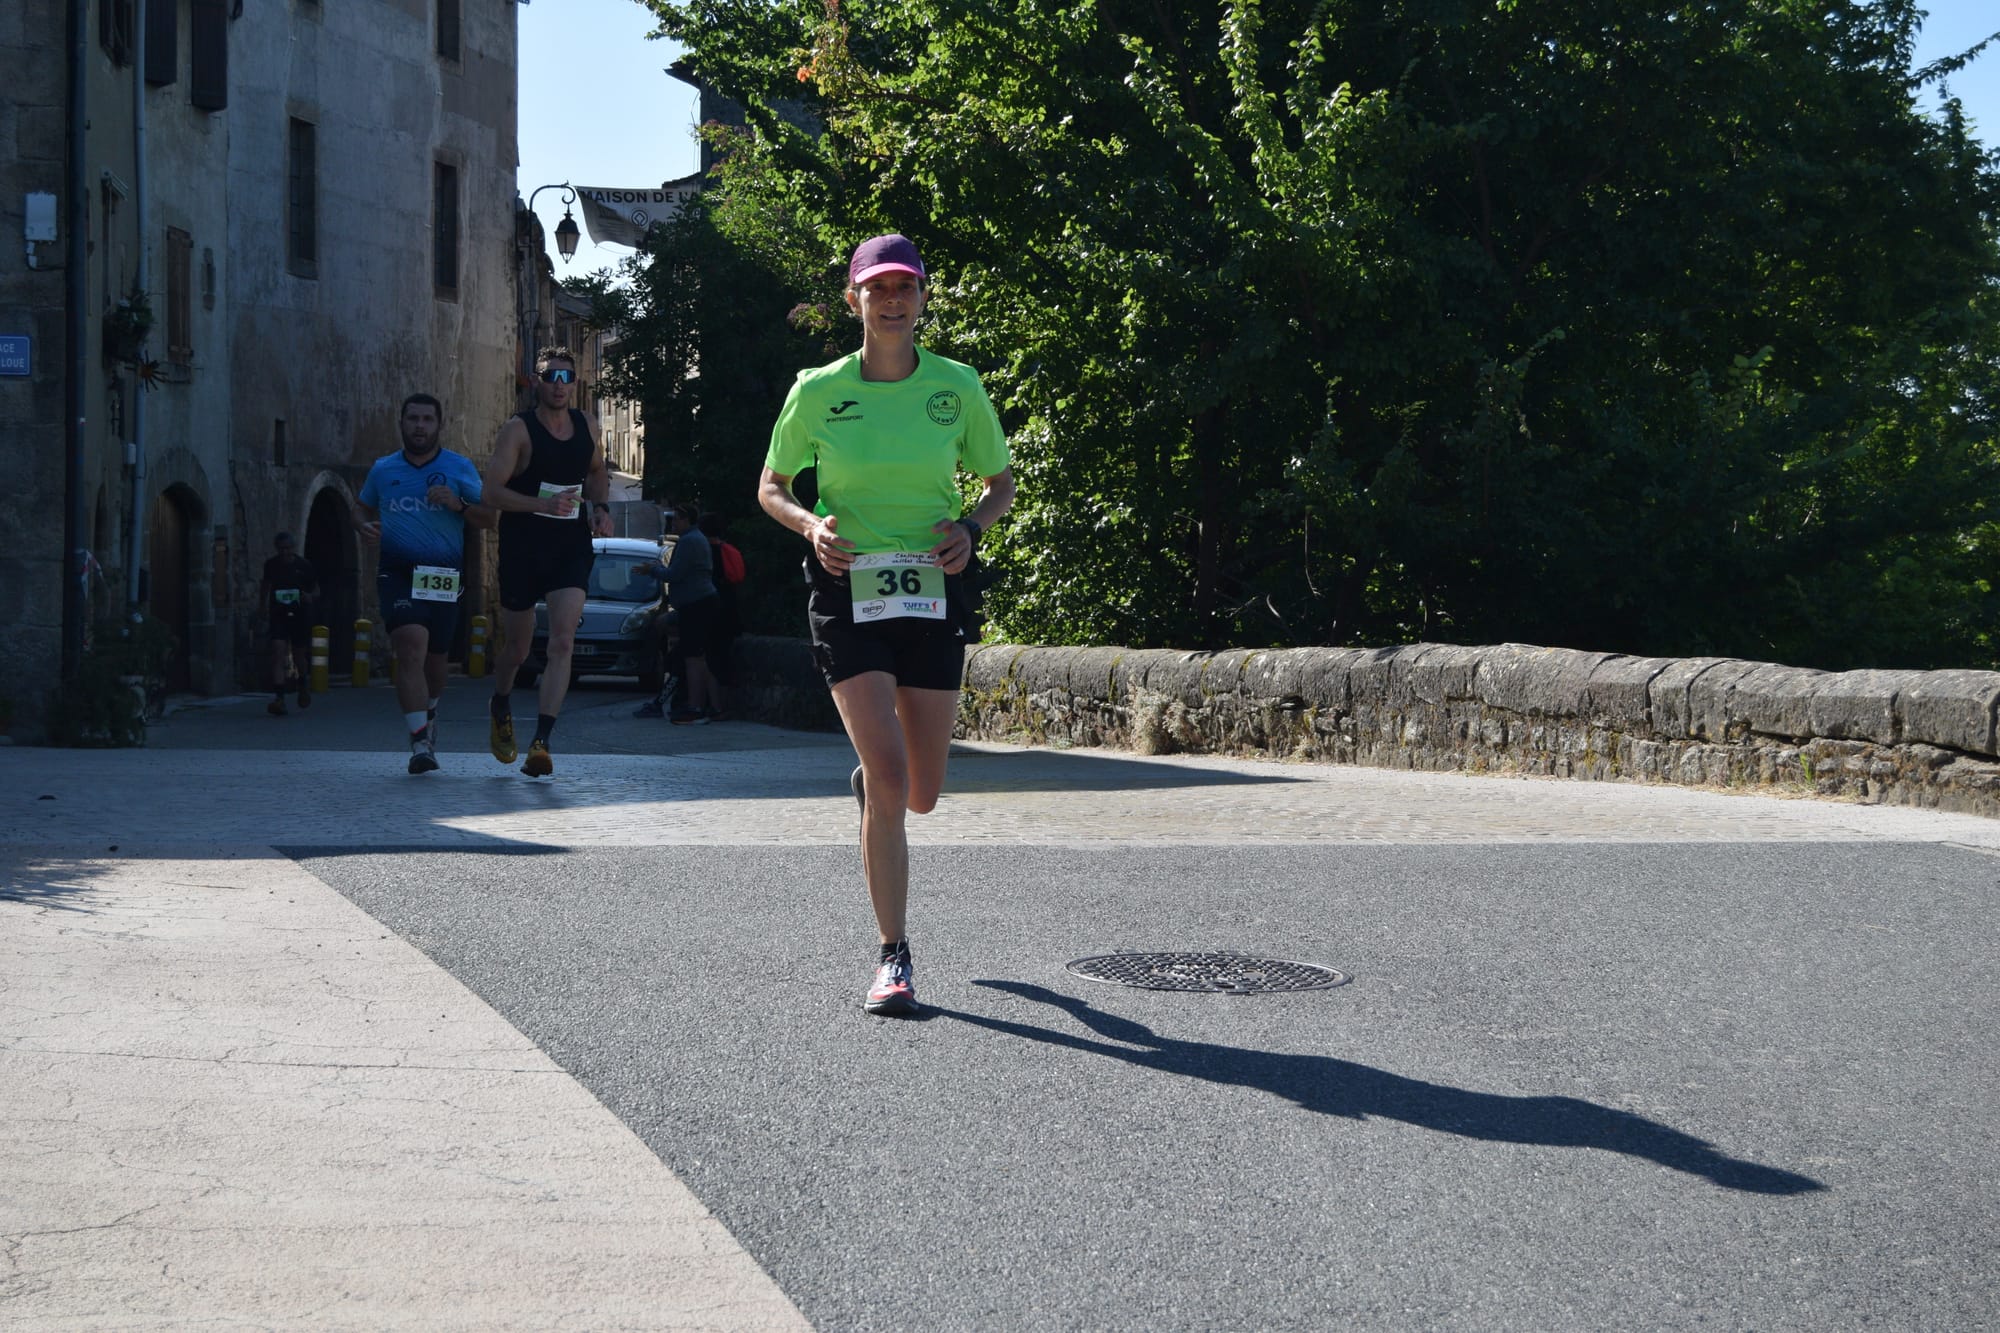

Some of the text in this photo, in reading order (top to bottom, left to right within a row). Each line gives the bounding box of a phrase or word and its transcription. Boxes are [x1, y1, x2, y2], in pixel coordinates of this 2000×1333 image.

[580, 191, 648, 203] MAISON
[653, 191, 674, 203] DE
[420, 575, 453, 591] 138
[876, 569, 921, 596] 36
